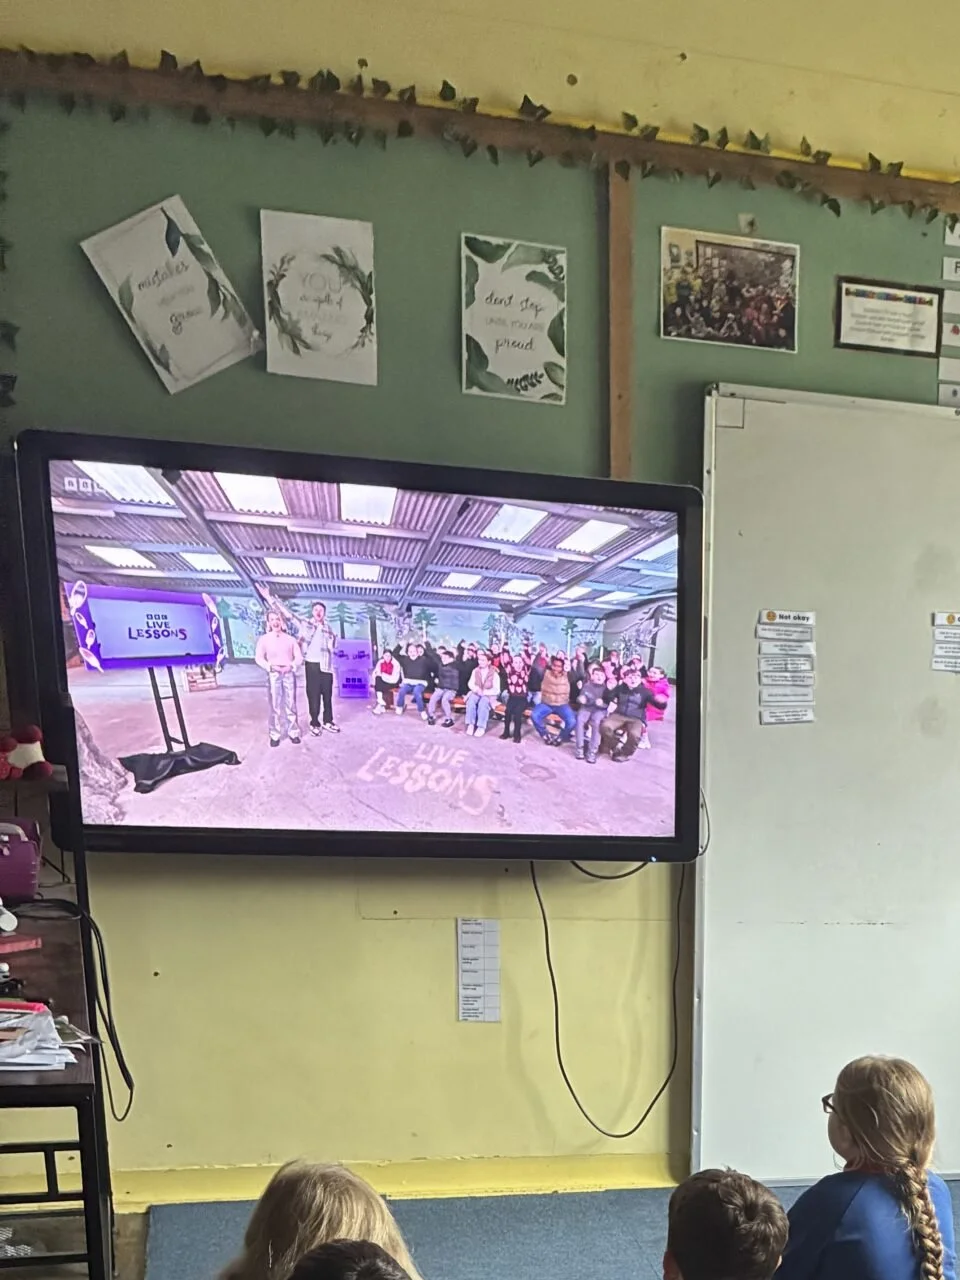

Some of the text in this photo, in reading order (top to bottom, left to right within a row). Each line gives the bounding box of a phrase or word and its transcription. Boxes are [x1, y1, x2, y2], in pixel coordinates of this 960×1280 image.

[302, 271, 343, 294] YOU
[520, 296, 545, 318] stop
[495, 337, 536, 354] proud
[146, 621, 171, 629] LIVE
[778, 613, 811, 622] Not okay
[128, 626, 188, 641] LESSONS
[414, 742, 469, 769] LIVE
[356, 746, 500, 816] LESSONS
